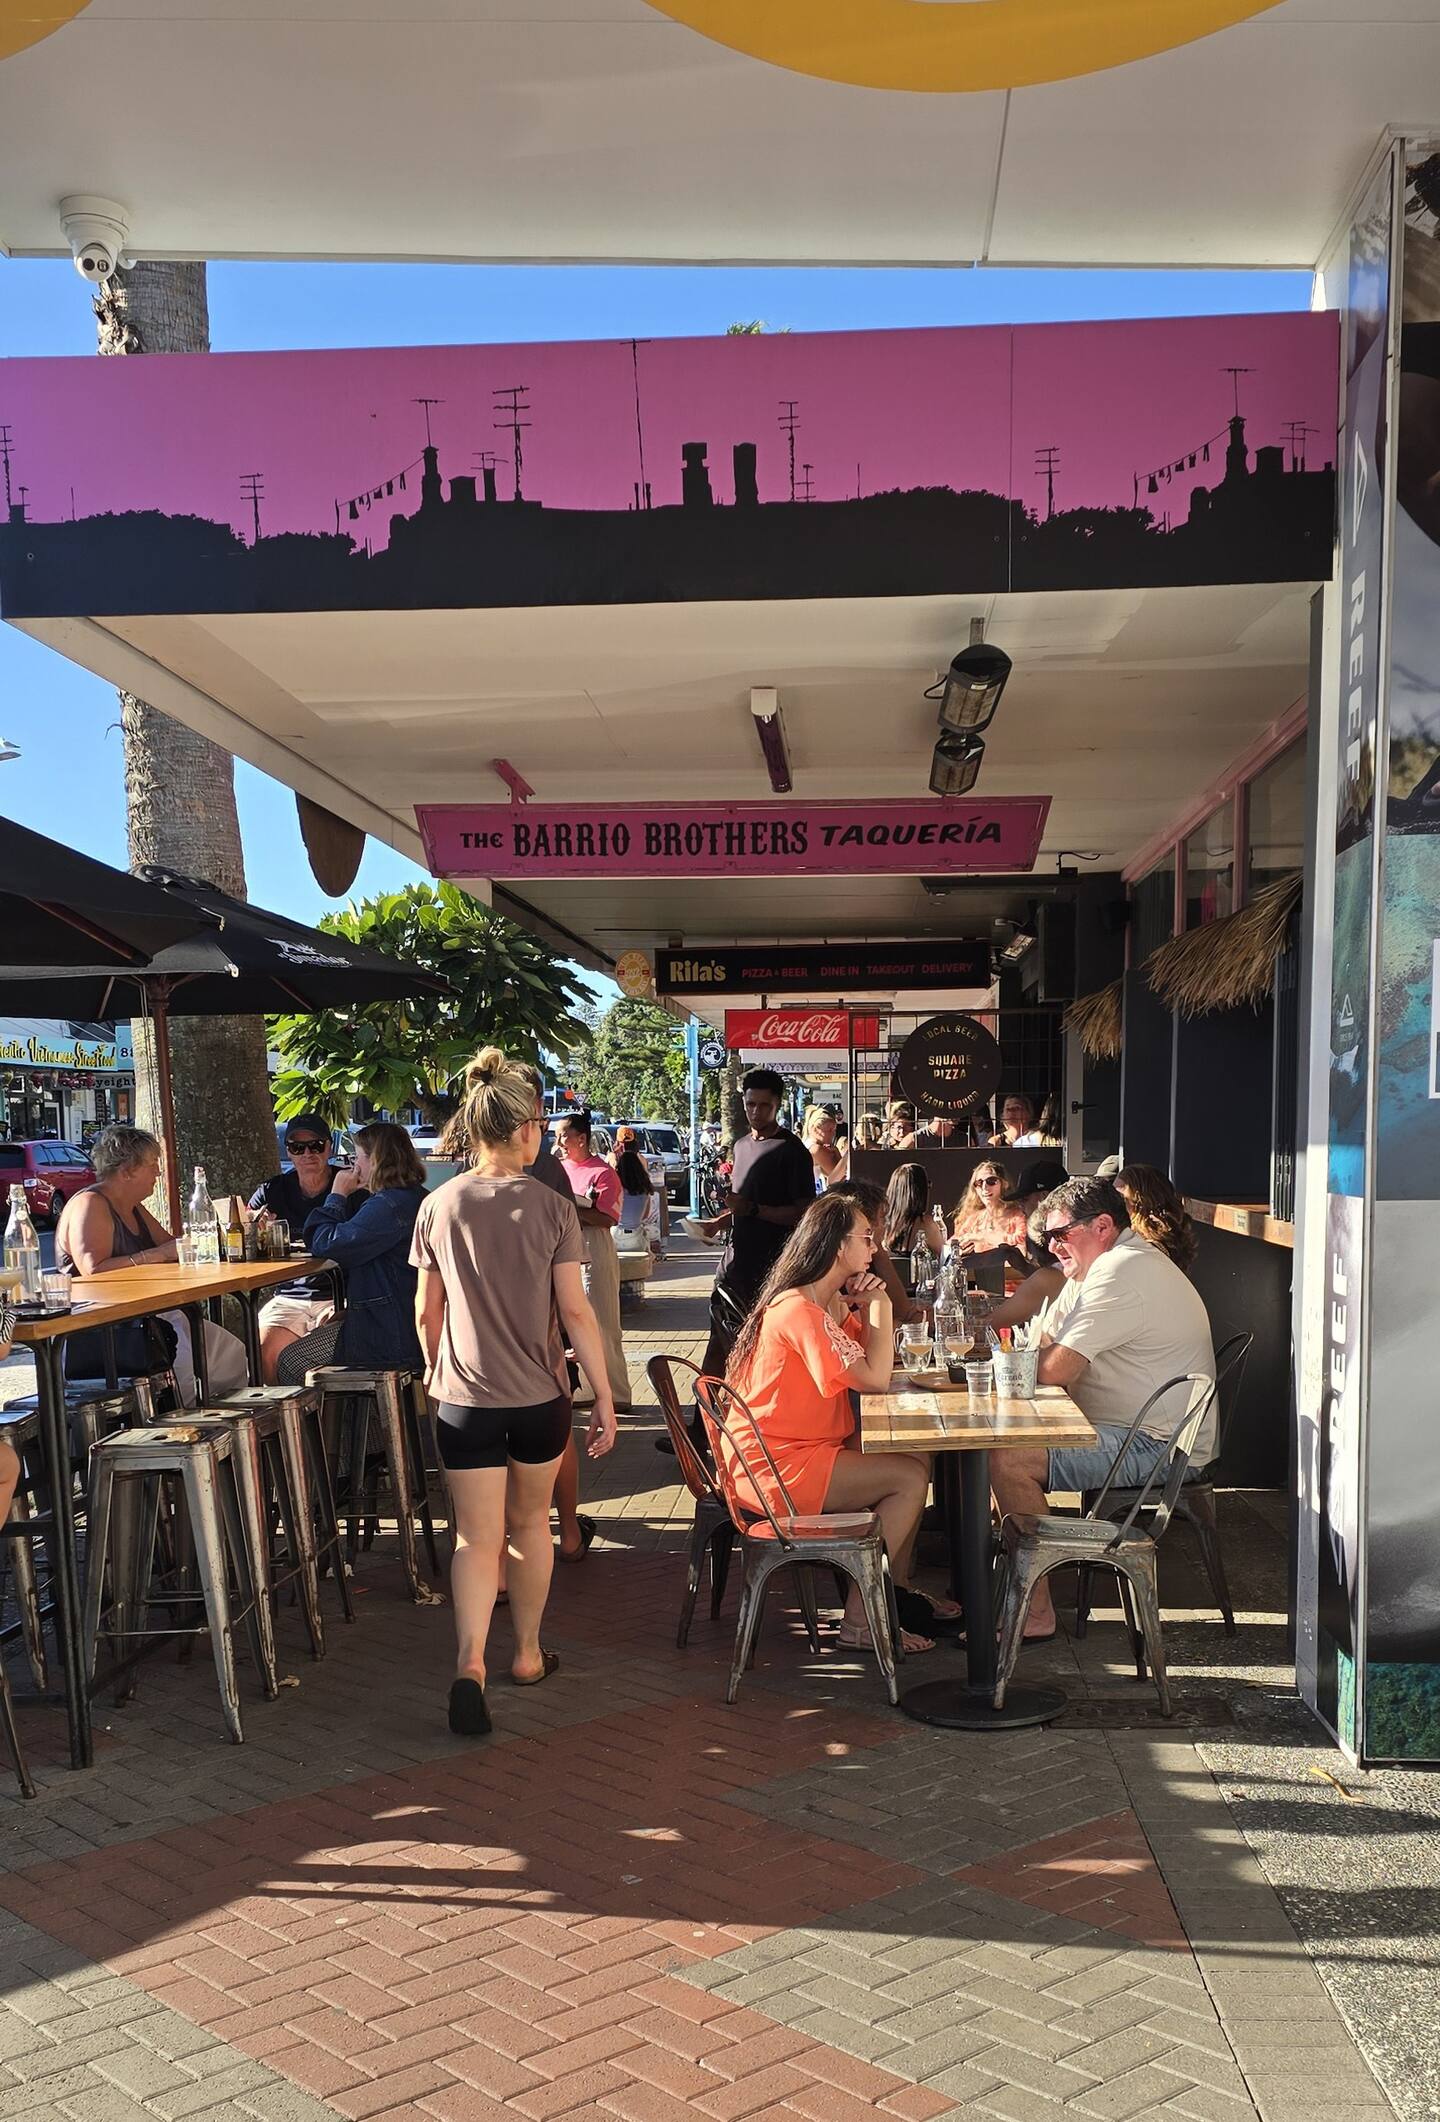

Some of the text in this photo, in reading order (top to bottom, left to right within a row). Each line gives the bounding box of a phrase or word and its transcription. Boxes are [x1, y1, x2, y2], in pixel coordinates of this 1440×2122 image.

[1346, 570, 1366, 782] REEF
[459, 816, 1001, 857] THE BARRIO BROTHERS TAQUERÍA
[670, 960, 727, 982] Rita's
[742, 968, 773, 978] PIZZA
[781, 967, 809, 977] BEER
[820, 966, 846, 977] DINE
[848, 966, 860, 976] IN
[866, 964, 915, 975] TAKEOUT
[921, 962, 974, 974] DELIVERY
[922, 1025, 979, 1041] LOCAL BEER
[928, 1054, 973, 1066] SQUARE
[933, 1068, 967, 1080] PIZZA
[920, 1090, 980, 1110] HARD LIQUOR
